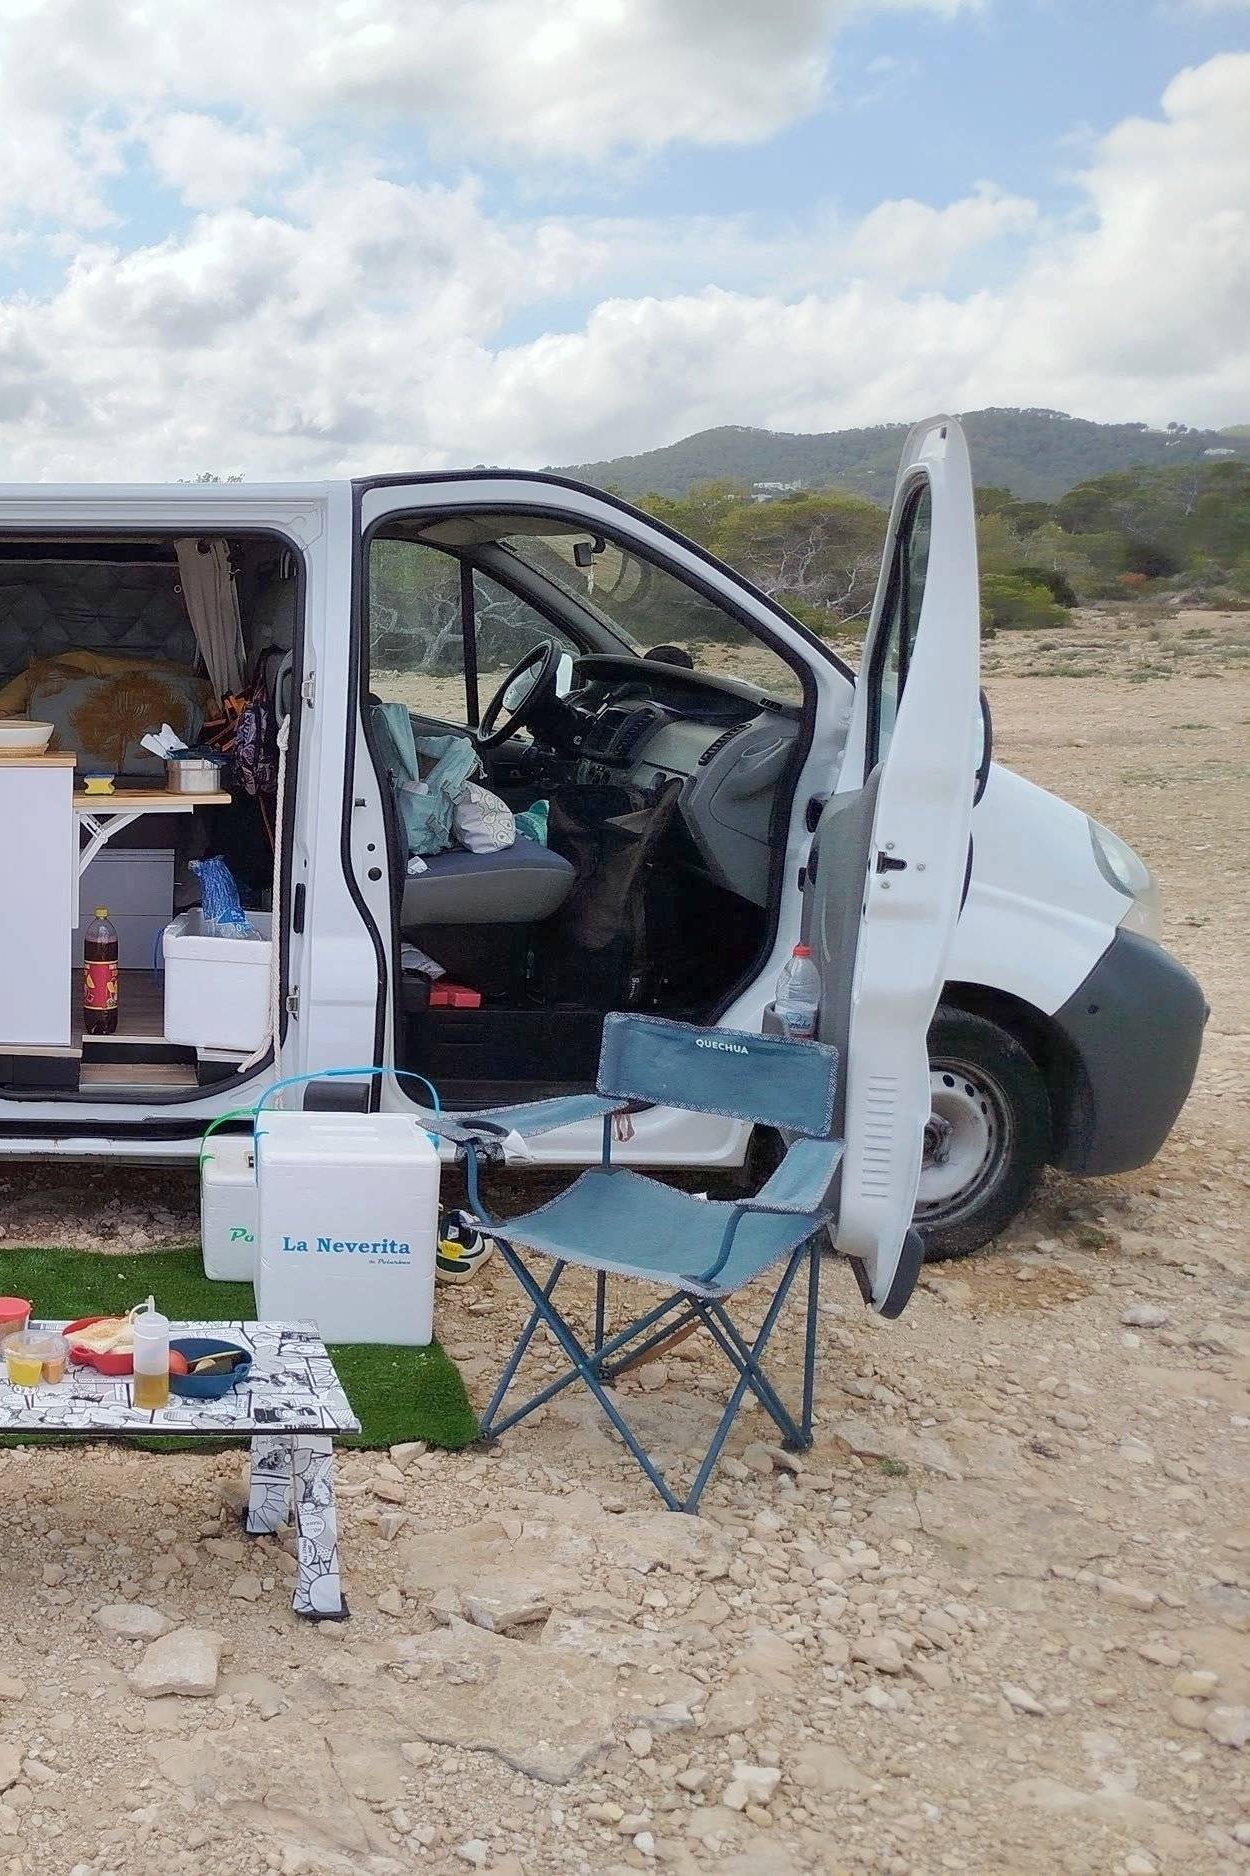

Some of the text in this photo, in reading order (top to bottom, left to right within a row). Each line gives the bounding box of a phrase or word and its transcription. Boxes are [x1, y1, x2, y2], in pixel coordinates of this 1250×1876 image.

[695, 1038, 749, 1055] QUECHUA
[282, 1236, 411, 1255] La Neverita
